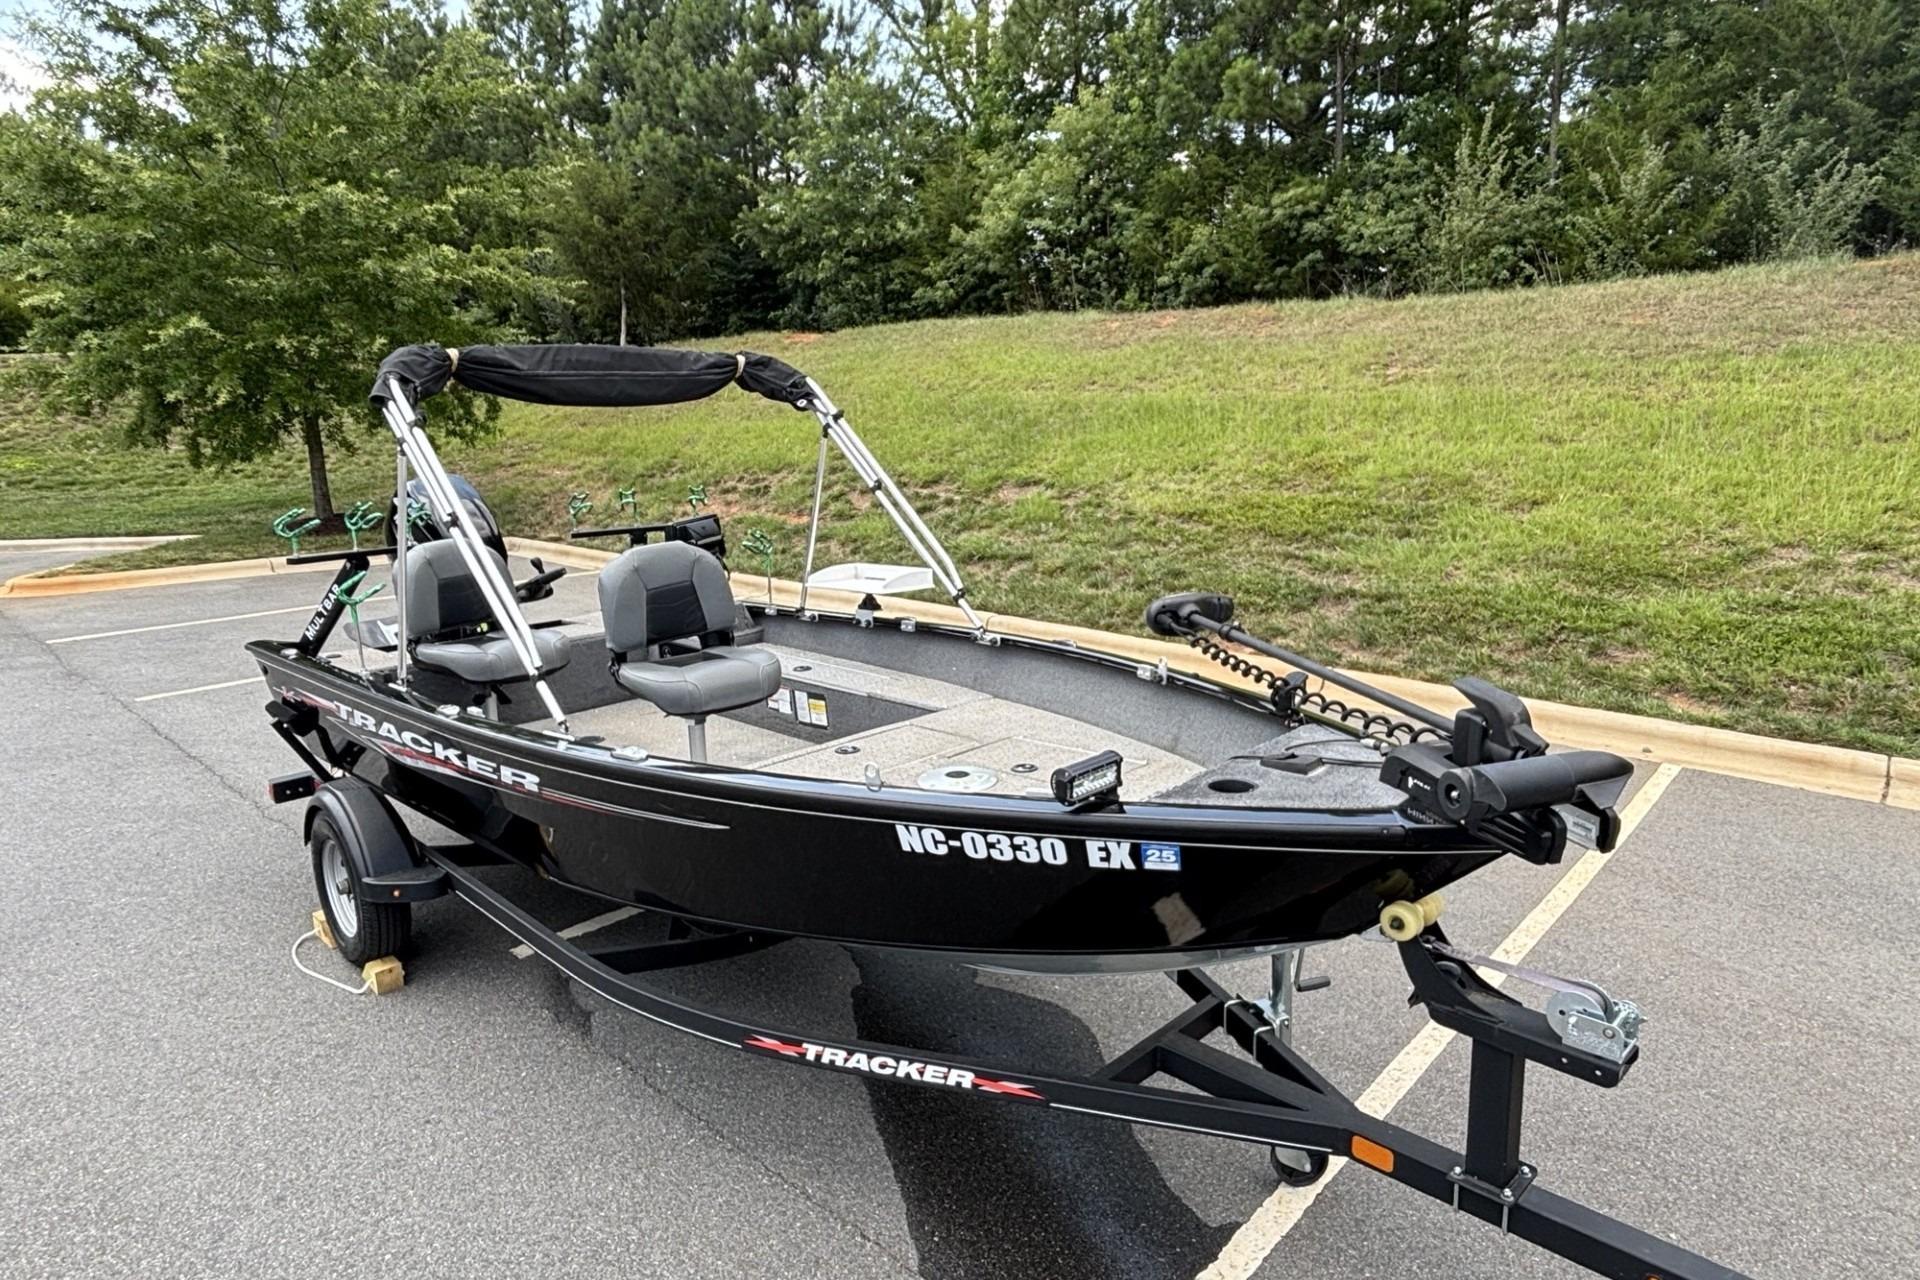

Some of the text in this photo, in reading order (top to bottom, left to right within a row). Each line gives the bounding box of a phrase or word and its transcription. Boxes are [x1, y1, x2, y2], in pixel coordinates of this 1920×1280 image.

[334, 701, 540, 792] TRACKER
[895, 824, 1136, 870] NC-0330 EX
[1146, 849, 1176, 862] 25
[802, 1043, 976, 1090] TRACKER
